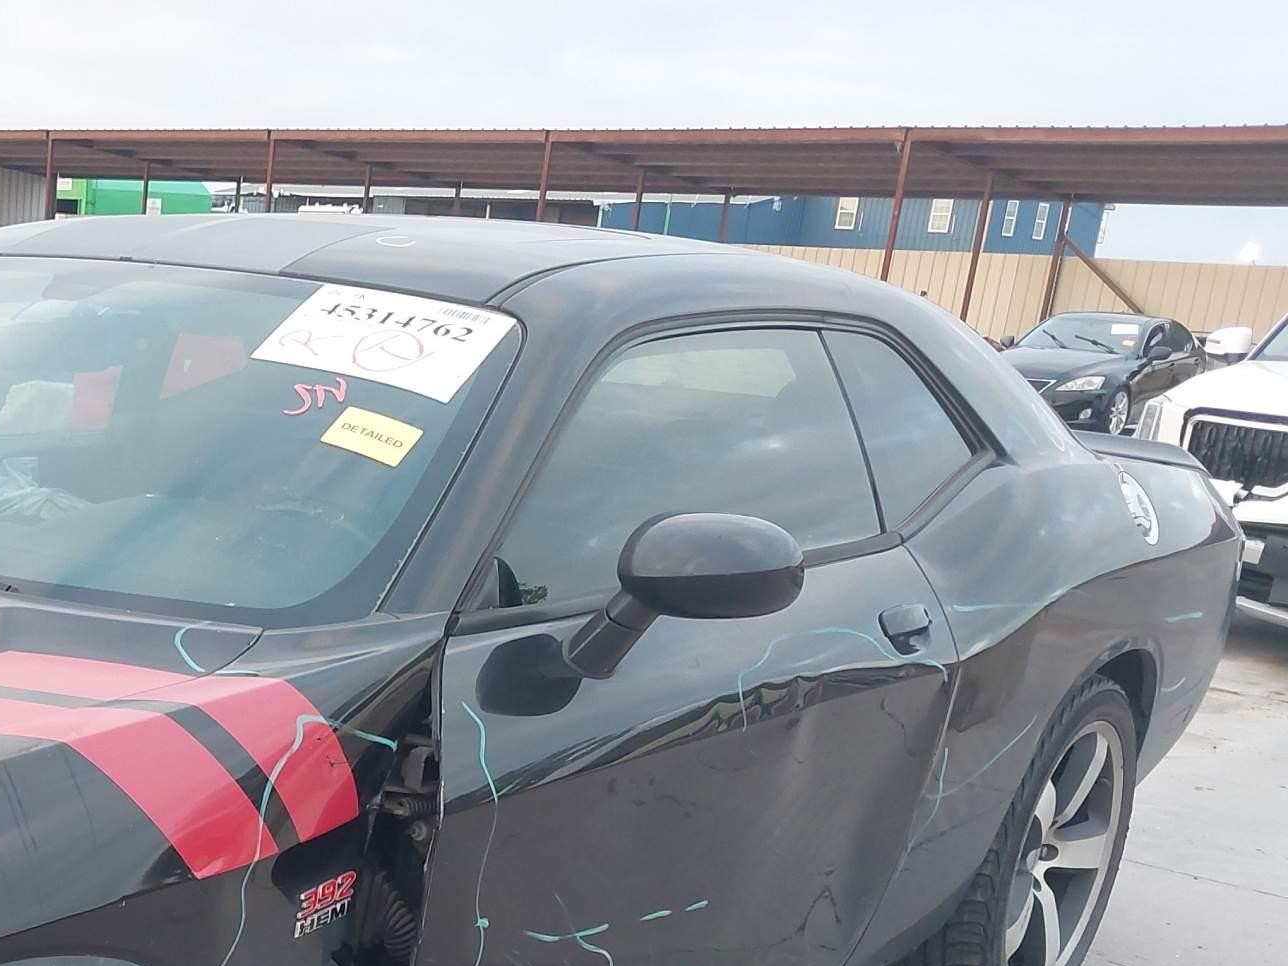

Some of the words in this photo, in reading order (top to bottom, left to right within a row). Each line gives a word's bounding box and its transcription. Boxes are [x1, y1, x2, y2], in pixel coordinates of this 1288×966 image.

[320, 303, 473, 342] 45314762
[340, 422, 404, 449] DETAILED
[296, 870, 357, 919] 392
